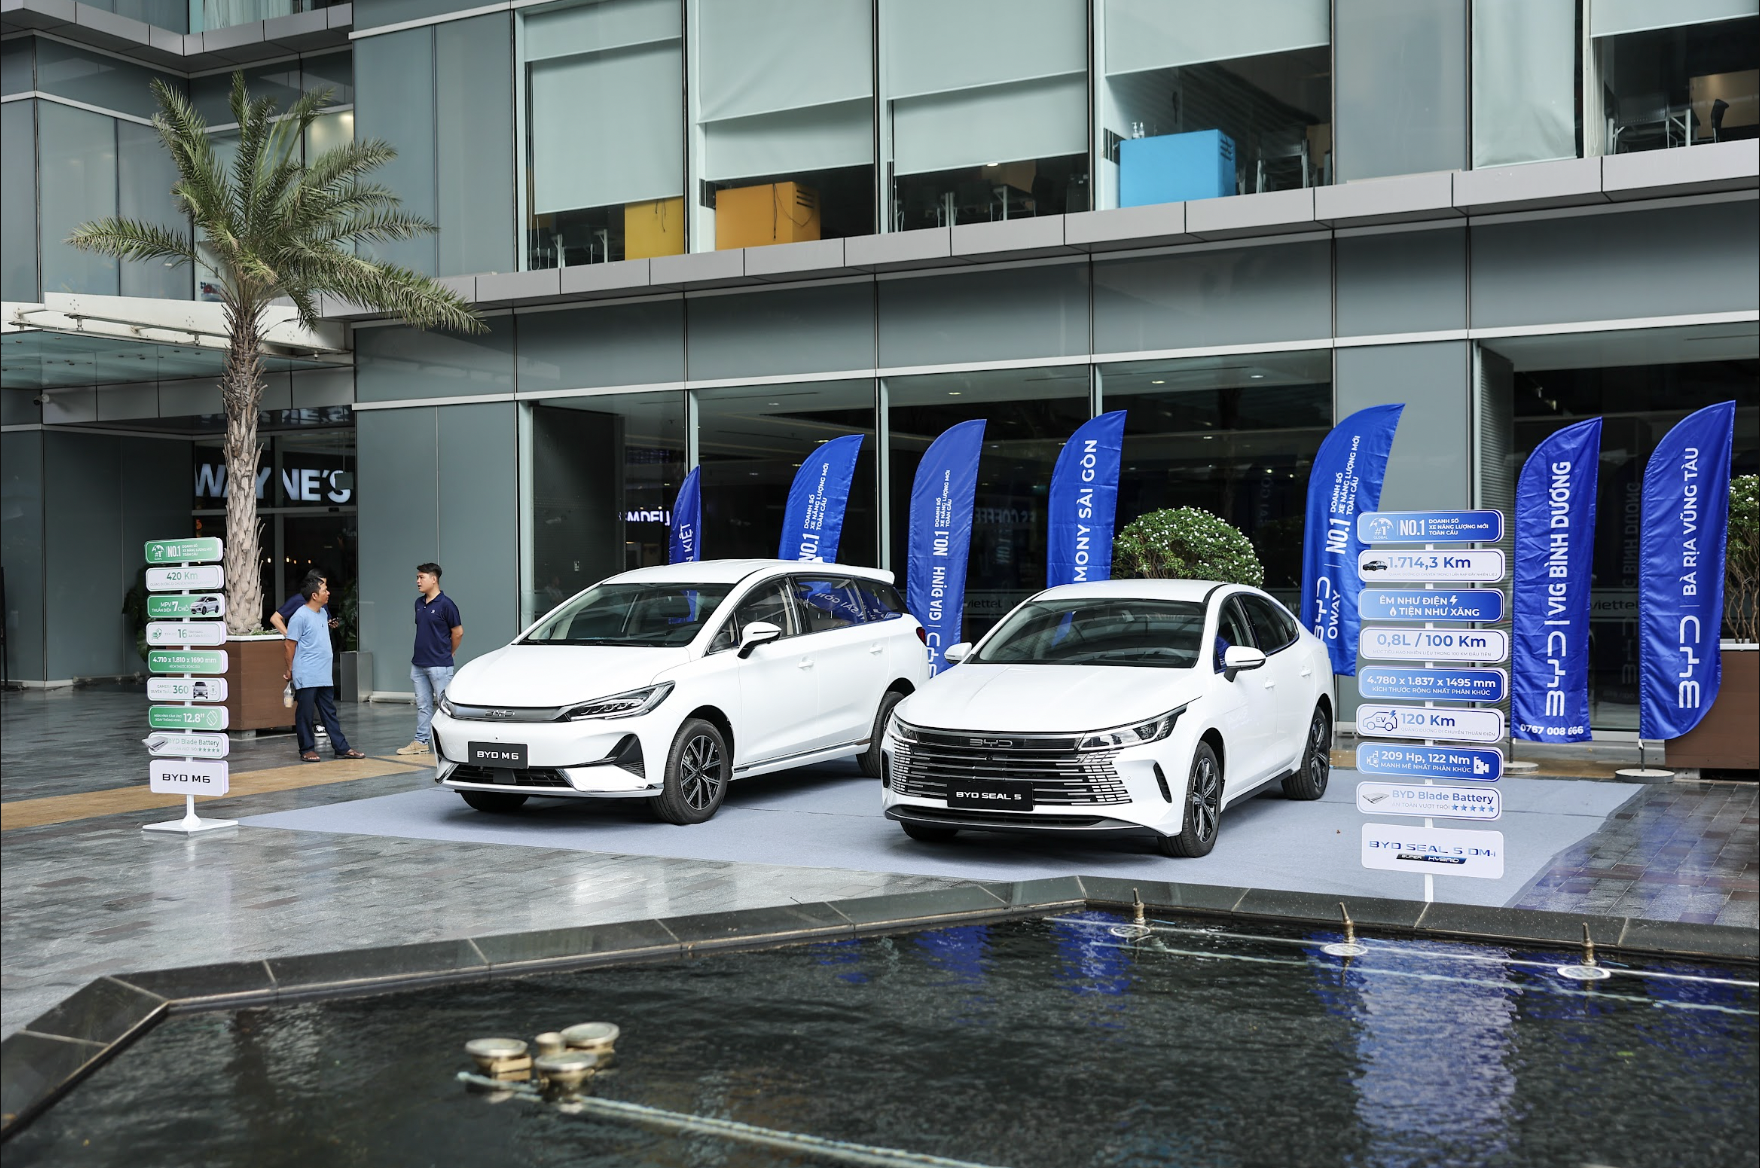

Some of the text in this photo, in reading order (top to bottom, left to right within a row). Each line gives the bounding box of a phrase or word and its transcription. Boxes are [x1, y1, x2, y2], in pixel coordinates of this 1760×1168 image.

[1080, 440, 1098, 482] GÒN
[1338, 435, 1360, 514] XE NĂNG LƯỢNG MỚI
[195, 463, 350, 503] WYNE'S
[1330, 472, 1343, 513] DOANH SỐ
[1346, 476, 1359, 515] TOÀN CẦU
[812, 501, 820, 518] NĂNG
[1076, 489, 1093, 518] SÀI
[804, 494, 815, 529] DOANH SỐ
[810, 519, 816, 529] XE
[816, 512, 824, 531] TOÀN
[1400, 519, 1425, 536] NO.1
[679, 523, 693, 553] KIỆT
[1325, 518, 1351, 554] NO.1
[798, 533, 820, 561] NO.1
[933, 531, 949, 556] NO.1
[167, 547, 181, 558] NO.1
[1387, 556, 1471, 570] 1.714,3 Km
[166, 571, 198, 580] 420 Km
[931, 567, 948, 597] ĐỊNH
[1679, 447, 1700, 708] BYD BÀ RỊA VŨNG TÀU
[1544, 461, 1571, 717] BYD VIG BÌNH DƯƠNG
[172, 601, 178, 611] 7
[1379, 595, 1447, 606] ÊM NHƯ ĐIỆN
[929, 600, 942, 620] GIA
[1327, 590, 1340, 639] OWAY
[1399, 607, 1480, 617] TIỆN NHƯ XĂNG
[178, 629, 188, 638] 16
[1377, 633, 1486, 647] 0,8L / 100 Km
[1367, 676, 1396, 684] 4.780
[1408, 677, 1434, 685] 1.837
[1446, 678, 1471, 687] 1495
[1473, 680, 1496, 688] mm
[172, 685, 189, 694] 360
[1412, 686, 1431, 694] RỘNG
[1472, 688, 1491, 696] KHÚC
[1401, 713, 1455, 727] 120 Km
[1520, 723, 1584, 735] 0767 008 666
[198, 739, 220, 748] Battery
[969, 739, 1013, 747] BYD
[476, 751, 499, 759] BYD
[1381, 751, 1470, 765] 209 Hp, 122 Nm
[1413, 763, 1431, 771] NHẤT
[162, 773, 211, 784] BYD M6
[956, 791, 979, 799] BYD
[981, 792, 1012, 800] SEAL
[1392, 790, 1494, 804] BYD Blade Battery
[1369, 841, 1401, 850] BYD
[1406, 844, 1448, 854] SEAL
